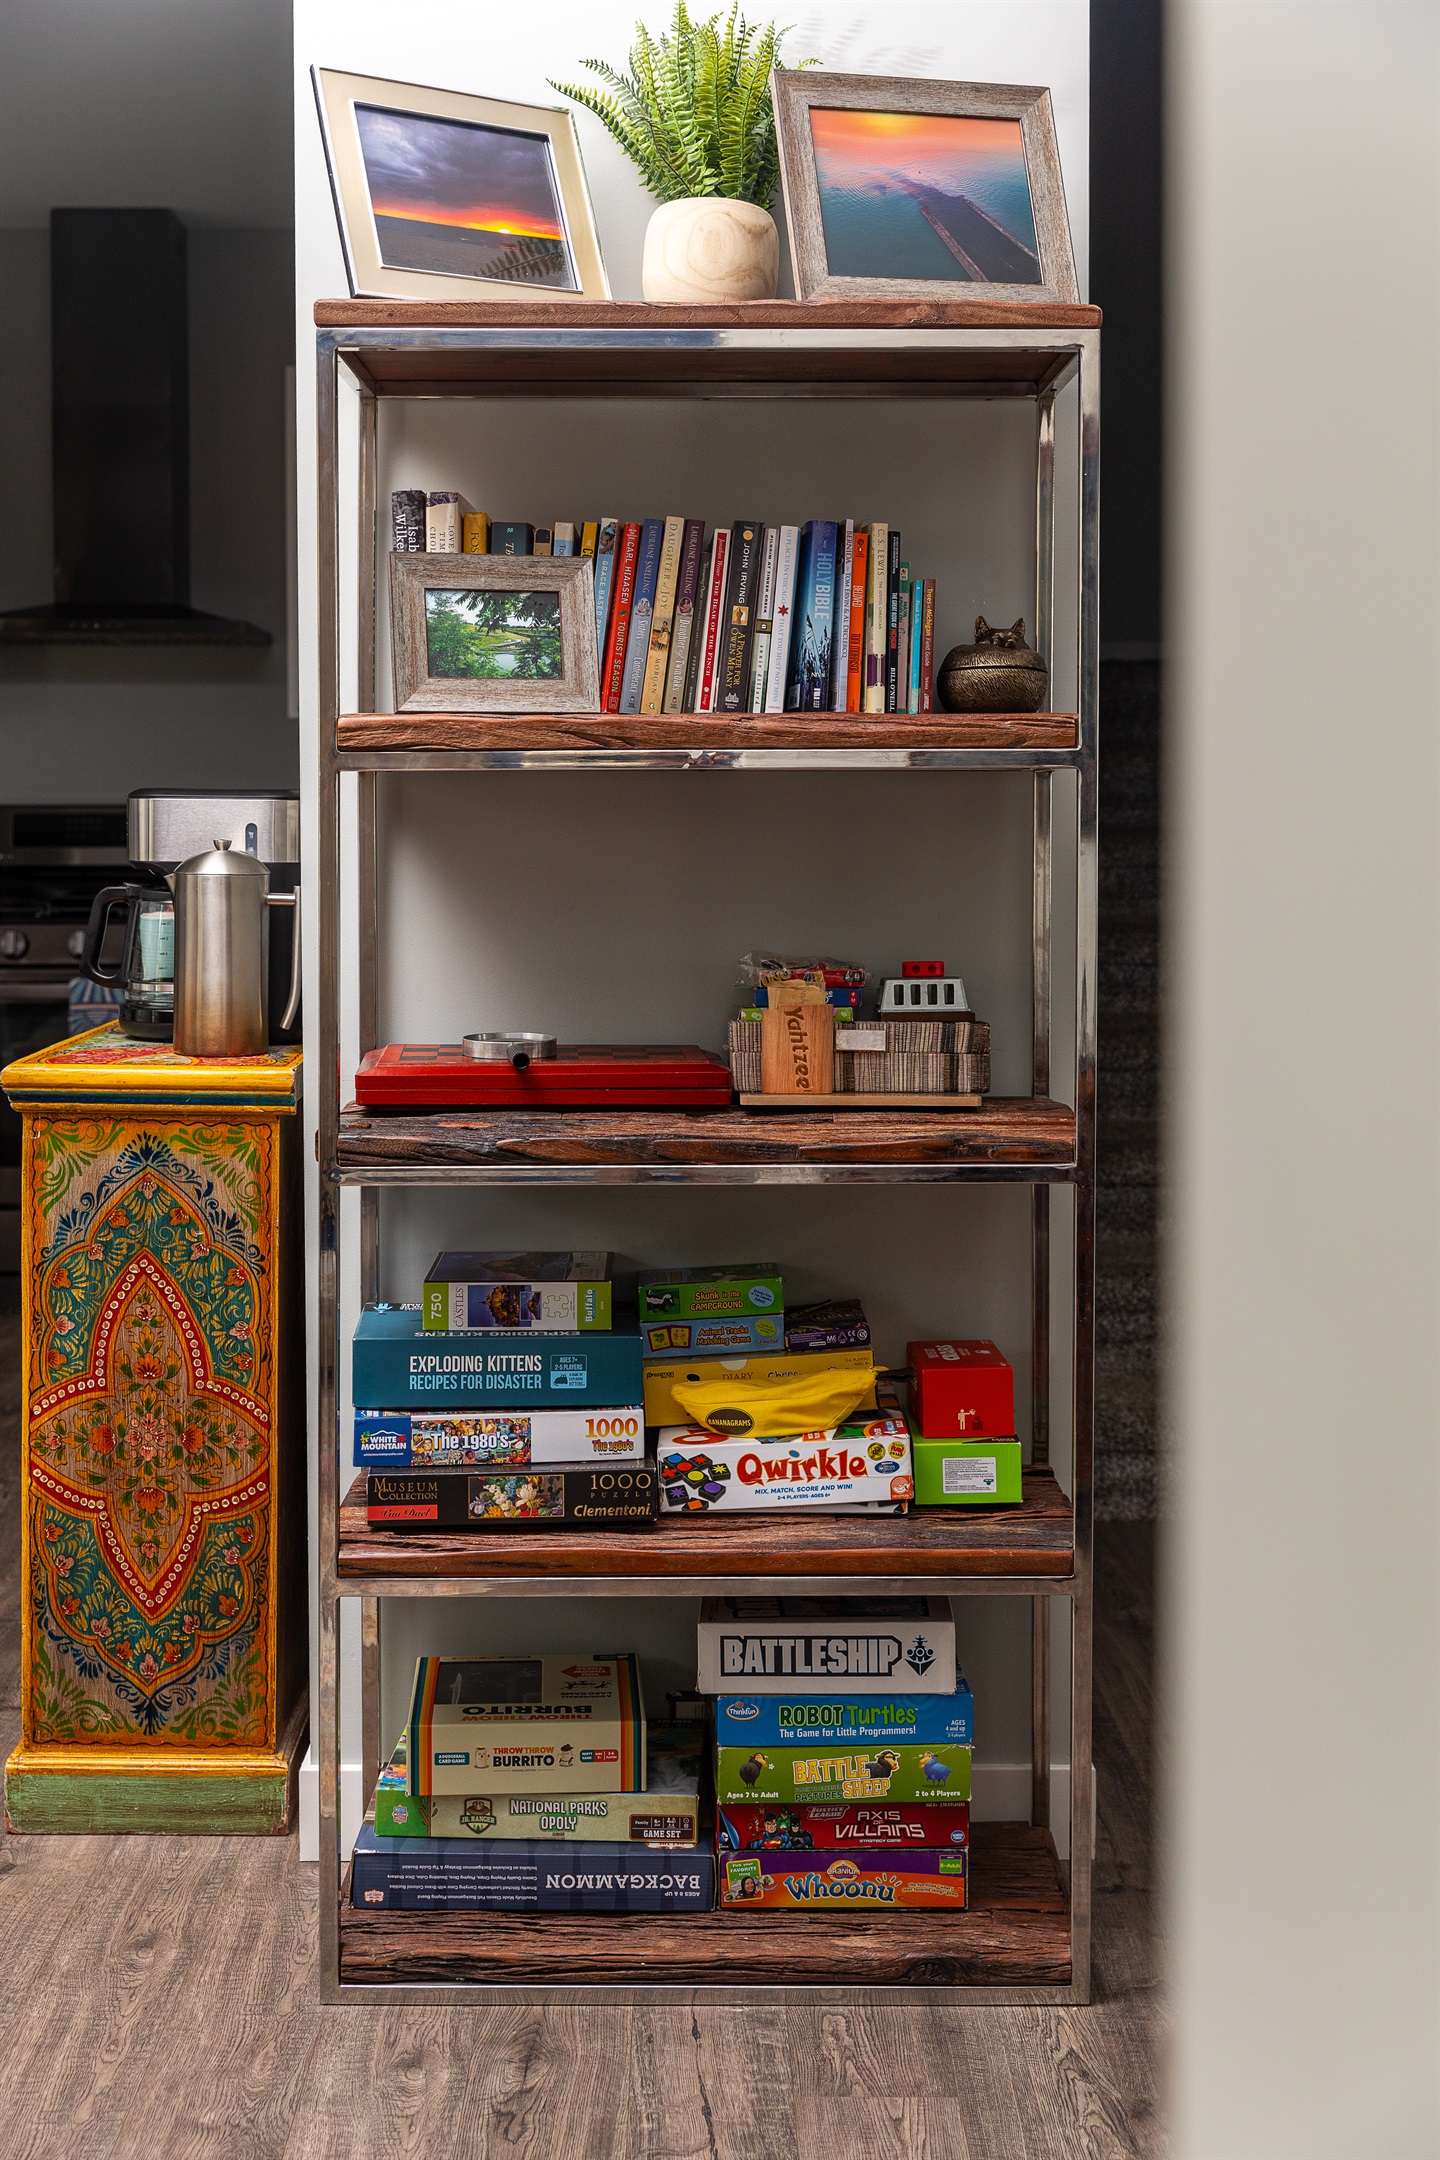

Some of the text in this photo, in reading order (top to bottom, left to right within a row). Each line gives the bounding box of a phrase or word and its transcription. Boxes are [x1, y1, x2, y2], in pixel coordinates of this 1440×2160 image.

[664, 523, 677, 579] DAUGHTER
[688, 526, 699, 559] LAURAINE
[716, 538, 725, 559] Jonathan
[845, 531, 853, 564] BERNIDA
[625, 542, 634, 563] CARL
[599, 561, 608, 587] GRACE
[684, 561, 695, 594] SNELLING
[738, 543, 750, 603] JOHN IRVING
[816, 553, 832, 584] HOLY
[621, 566, 632, 604] HIAASEN
[713, 580, 721, 596] THE
[596, 590, 606, 615] BASED
[660, 591, 669, 609] JOY
[814, 584, 829, 619] BIBLE
[710, 622, 716, 632] OF
[843, 615, 849, 623] AL
[924, 609, 933, 636] Michigan
[615, 621, 626, 656] TOURIST
[677, 619, 689, 649] Daughter
[849, 585, 863, 674] BELOVED TONI MORRISON
[729, 628, 739, 654] OWEN
[841, 625, 849, 660] DECLERCQ
[734, 640, 745, 668] PRAYER
[612, 660, 621, 692] SEASON
[651, 658, 660, 694] MORGAN
[675, 660, 684, 676] Twin
[726, 657, 736, 688] MEANY
[672, 676, 682, 691] Oaks
[733, 671, 741, 685] FOR
[784, 1006, 810, 1090] Yahtzee
[585, 1288, 594, 1322] Buffalo
[695, 1292, 720, 1300] Skunk
[430, 1293, 442, 1320] 750
[456, 1286, 465, 1328] CASTLES
[690, 1300, 744, 1311] CAMPGROUND
[696, 1336, 730, 1346] Matching
[731, 1335, 751, 1344] Game
[698, 1327, 724, 1336] Animal
[726, 1327, 749, 1335] Tracks
[410, 1354, 542, 1373] EXPLODING KITTENS
[410, 1374, 542, 1390] RECIPES FOR DISASTER
[722, 1372, 753, 1380] DIARY
[586, 1418, 638, 1439] 1000
[361, 1442, 407, 1451] MOUNTAIN
[370, 1436, 397, 1444] WHITE
[432, 1432, 510, 1450] The 1980's
[592, 1439, 634, 1453] The 1980's
[737, 1448, 868, 1485] Qwirkle
[374, 1477, 438, 1494] MUSEUM
[591, 1474, 652, 1490] 1000
[754, 1487, 769, 1495] MIX,
[771, 1486, 794, 1494] MATCH,
[821, 1484, 835, 1492] AND
[378, 1490, 438, 1501] COLLECTION
[591, 1490, 651, 1498] PUZZLE
[722, 1638, 899, 1674] BATTLESHIP
[461, 1705, 593, 1715] BURRITO
[778, 1704, 917, 1727] ROBOT Turtles
[780, 1725, 916, 1738] The Game for Little Programmers!
[493, 1746, 554, 1755] THROW THROW
[493, 1755, 554, 1767] BURRITO
[792, 1754, 870, 1784] BATTLE
[794, 1791, 842, 1802] PASTURES
[842, 1778, 890, 1799] SHEEP
[936, 1790, 960, 1798] Players
[510, 1799, 608, 1816] NATIONAL PARKS
[809, 1811, 843, 1819] LEAGUE
[857, 1810, 901, 1822] AXIS
[461, 1815, 496, 1825] JR. RANGER
[540, 1815, 578, 1831] OPOLY
[642, 1829, 681, 1839] GAME SET
[834, 1824, 926, 1839] VILLAINS
[545, 1874, 700, 1889] BACKGAMMON
[783, 1872, 896, 1902] Whoonu
